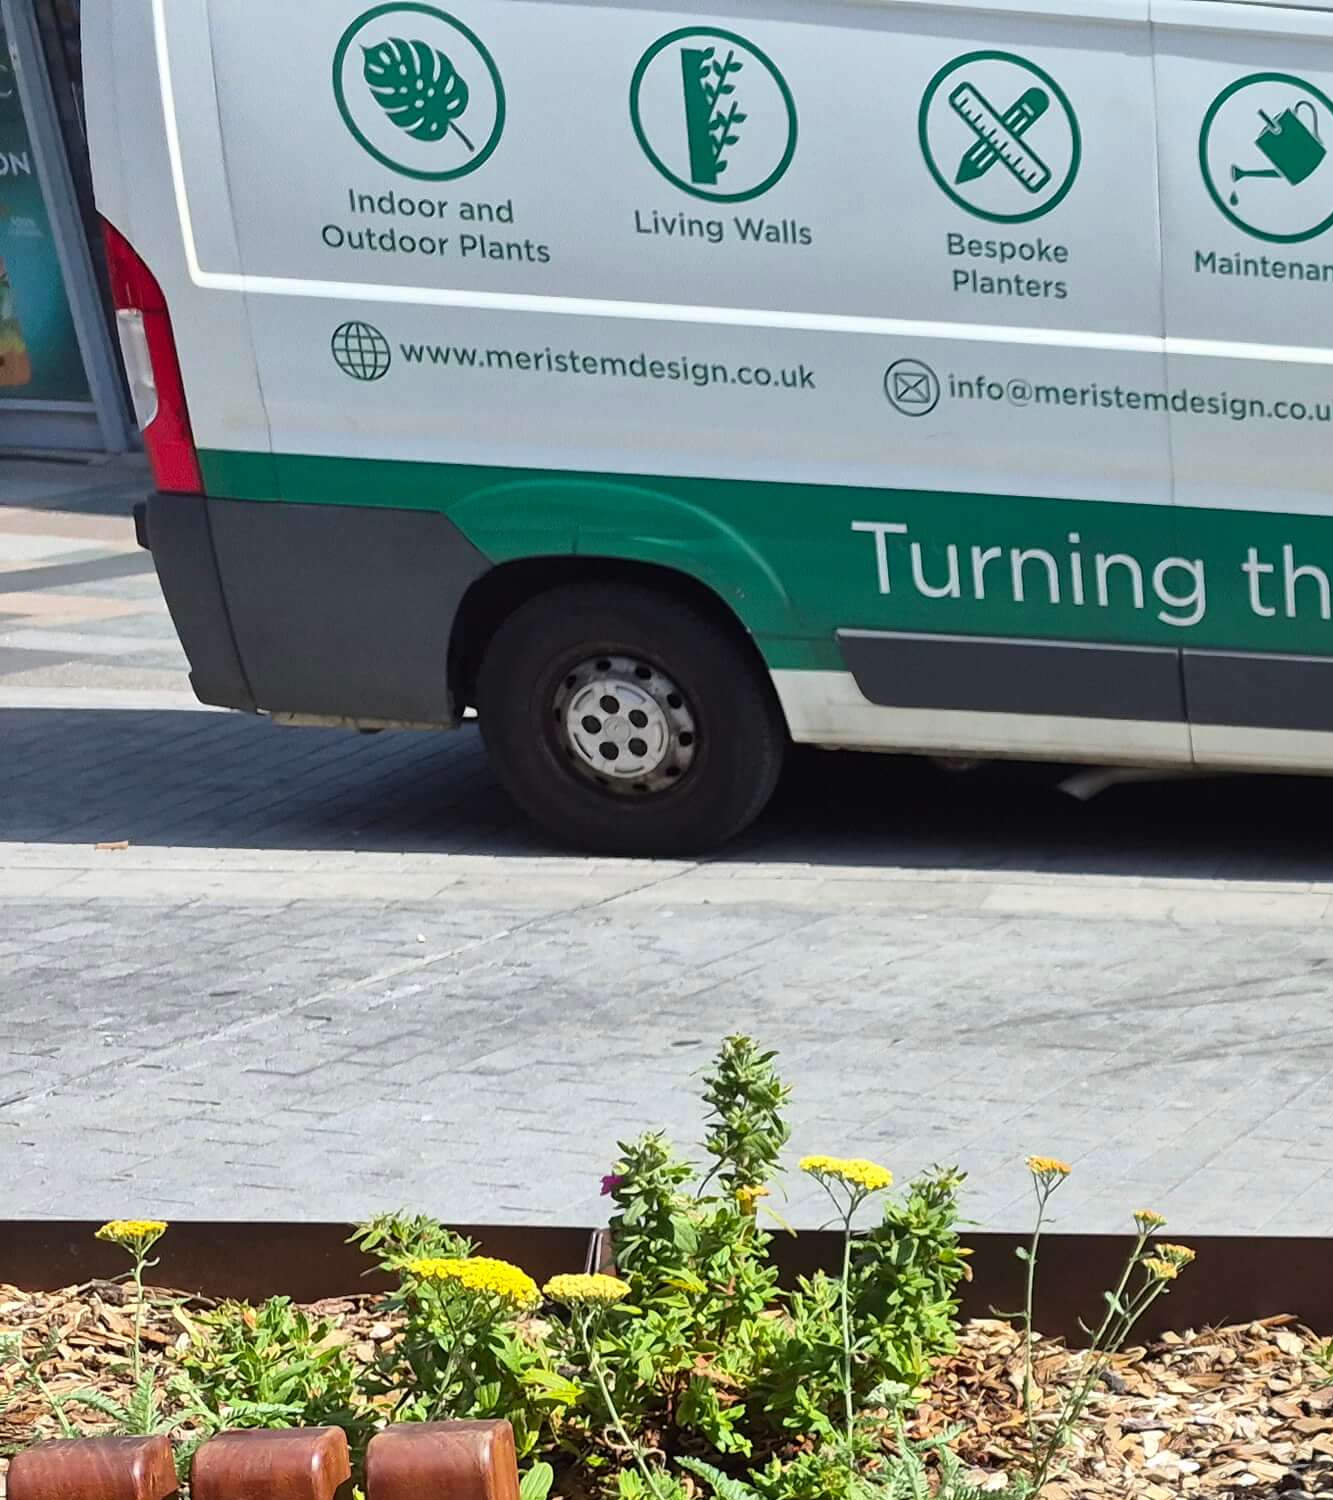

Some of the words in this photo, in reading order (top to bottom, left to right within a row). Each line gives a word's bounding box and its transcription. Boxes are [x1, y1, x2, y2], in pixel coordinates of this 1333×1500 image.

[349, 189, 448, 219] Indoor
[459, 200, 515, 225] and
[321, 224, 449, 257] Outdoor
[460, 234, 551, 264] Plants
[635, 210, 723, 244] Living
[734, 217, 813, 246] Walls
[947, 233, 1069, 268] Bespoke
[953, 269, 1068, 300] Planters
[399, 343, 816, 390] www.meristemdesign.co.uk
[852, 521, 1206, 626] Turning
